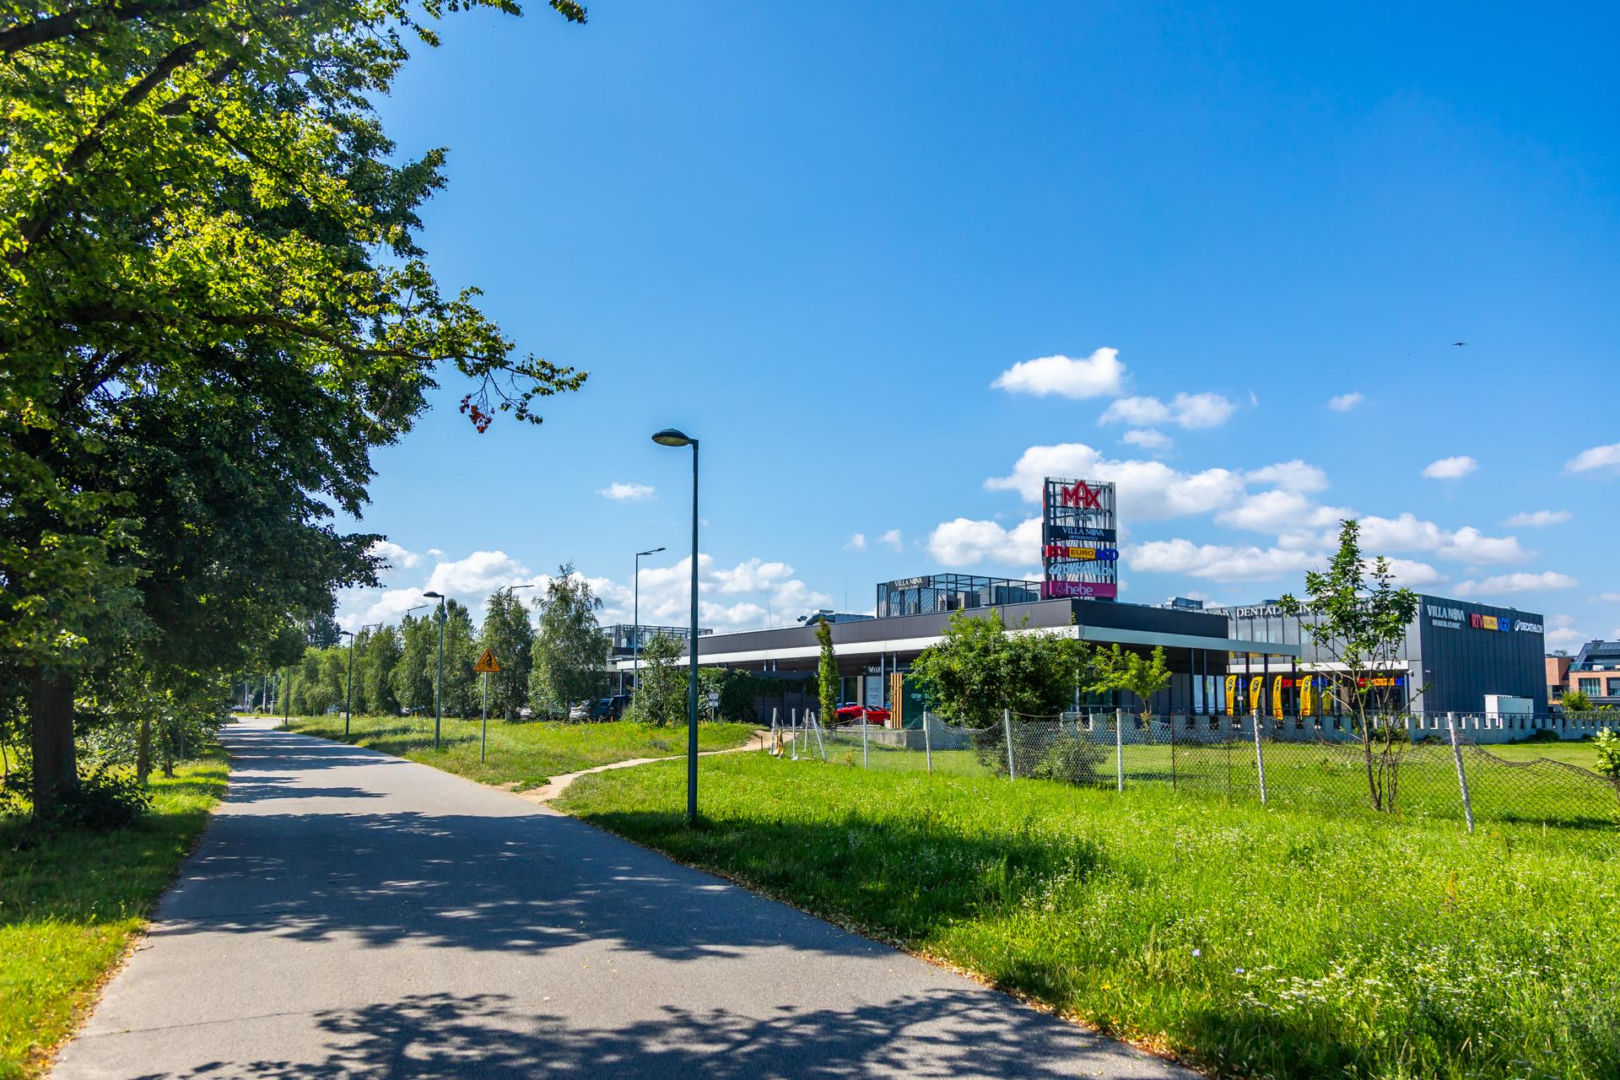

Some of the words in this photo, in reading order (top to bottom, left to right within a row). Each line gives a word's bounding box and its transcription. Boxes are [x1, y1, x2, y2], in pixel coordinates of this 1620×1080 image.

[1062, 480, 1101, 510] MAX
[1062, 527, 1085, 535] VILLA
[1070, 548, 1095, 557] EURO
[1066, 583, 1093, 595] hebe
[1237, 606, 1280, 617] DENTAL
[1427, 605, 1448, 618] VILLA
